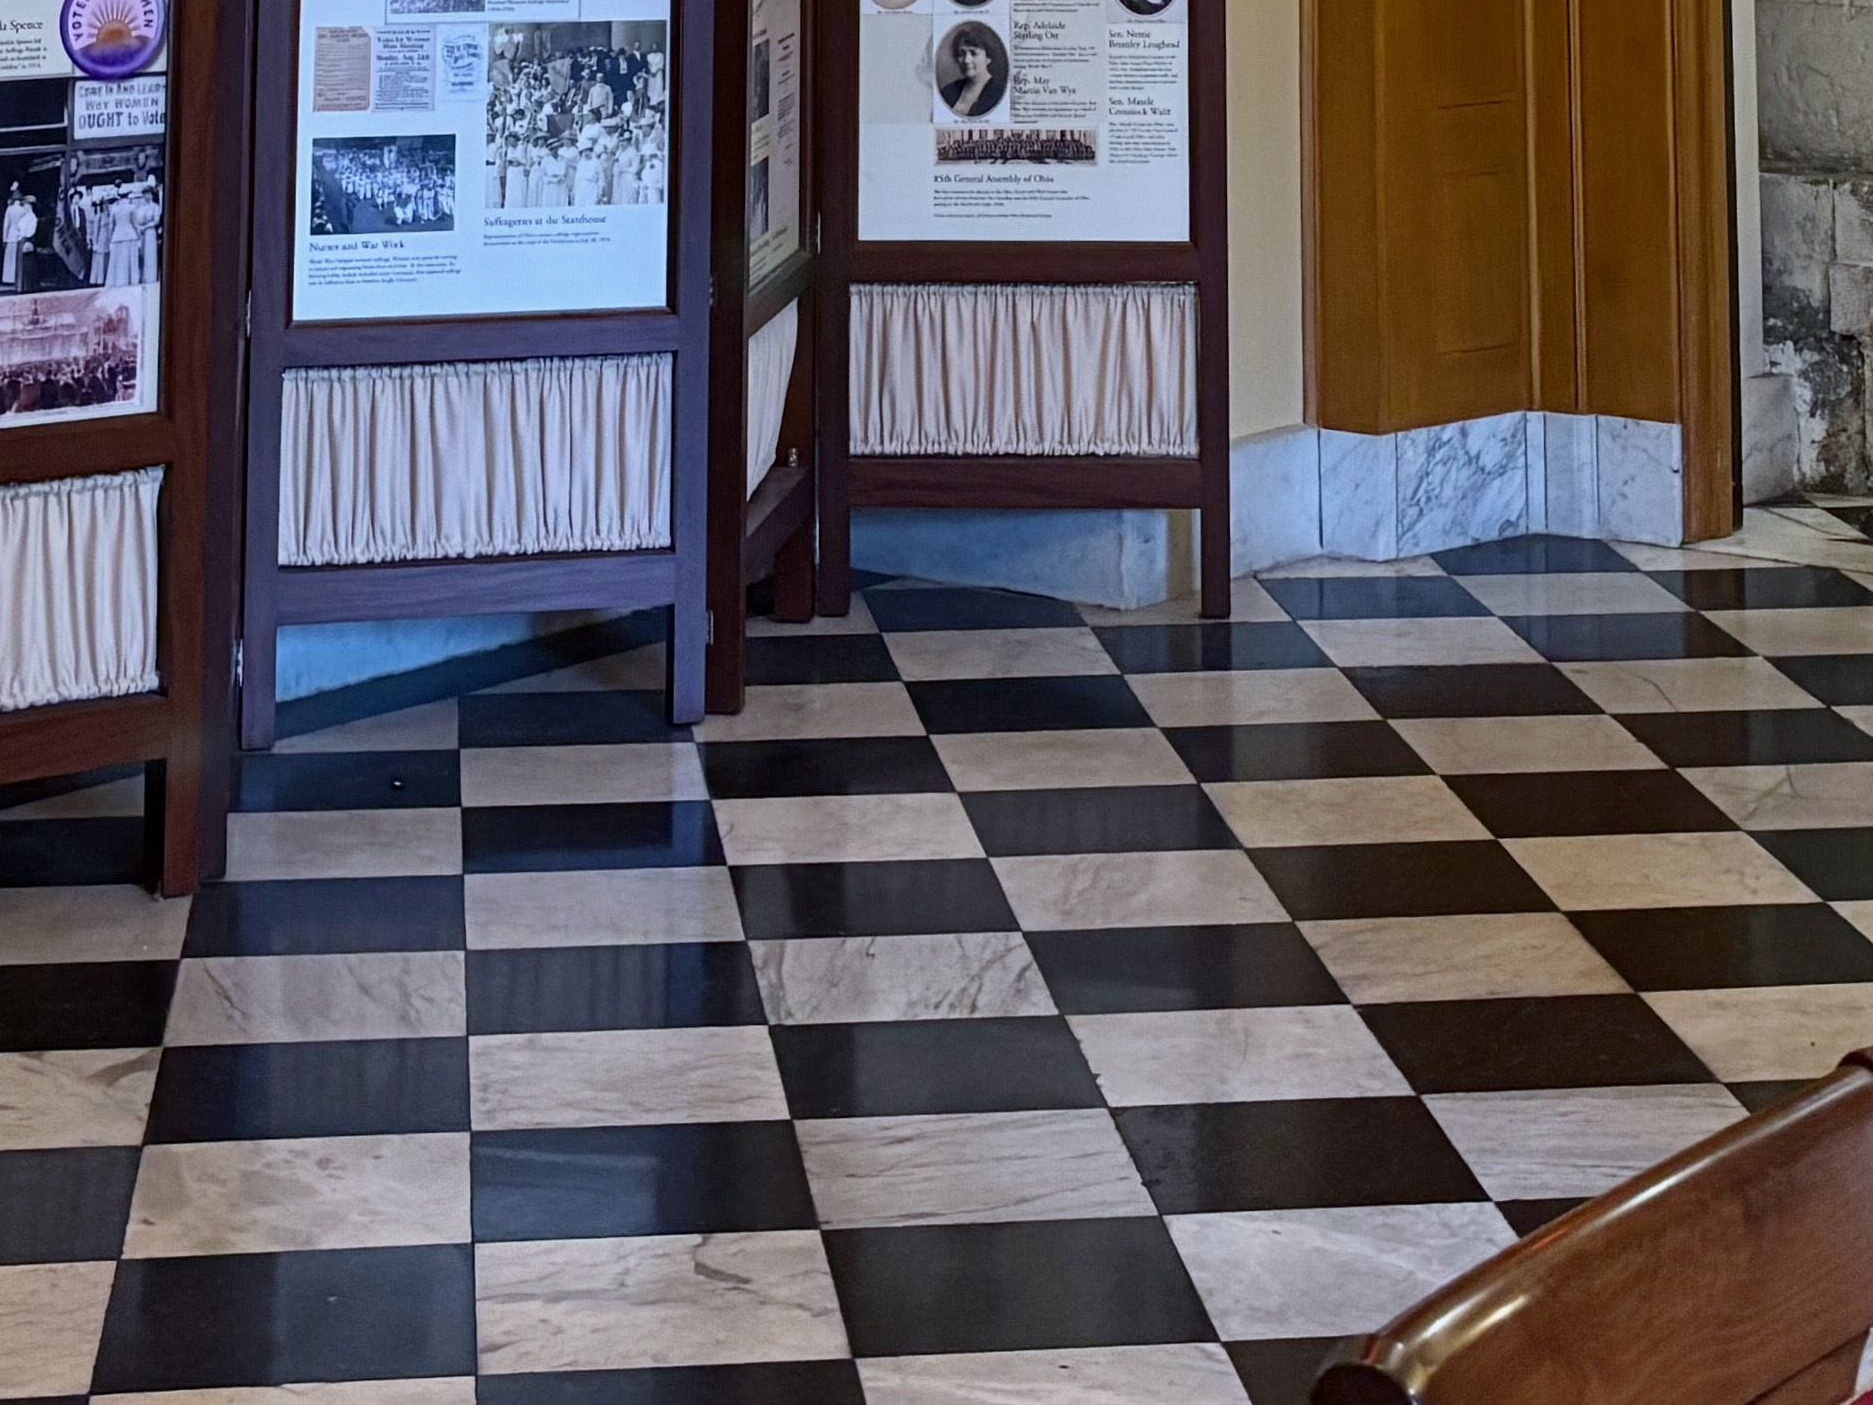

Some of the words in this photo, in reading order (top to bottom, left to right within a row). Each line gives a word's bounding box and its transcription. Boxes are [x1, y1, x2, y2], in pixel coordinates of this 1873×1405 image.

[115, 97, 159, 109] WOMEN
[79, 112, 123, 129] OUGHT
[128, 112, 139, 126] to
[954, 175, 984, 183] General
[985, 175, 1021, 185] Assembly
[1033, 175, 1054, 183] Ohio
